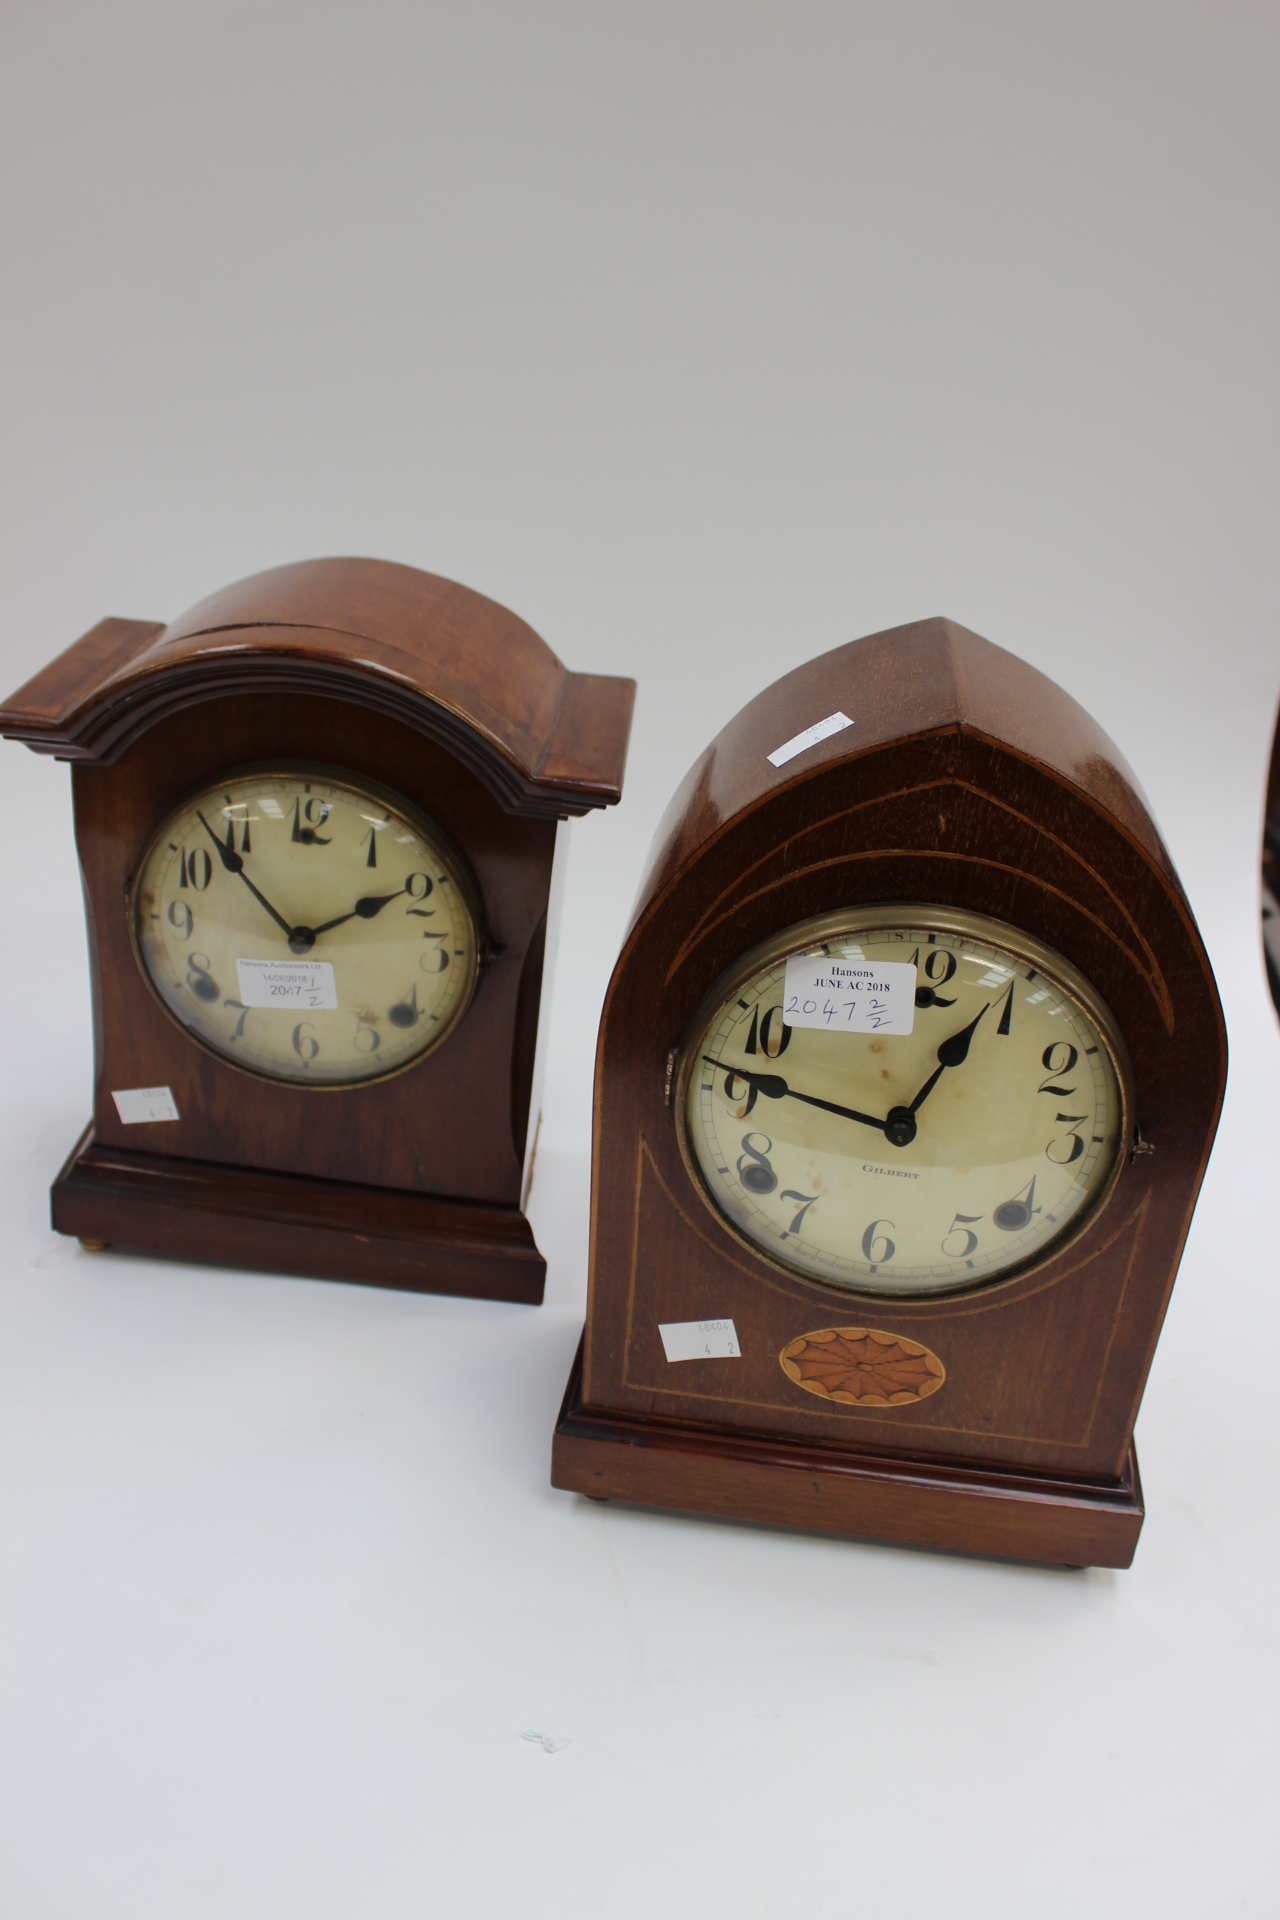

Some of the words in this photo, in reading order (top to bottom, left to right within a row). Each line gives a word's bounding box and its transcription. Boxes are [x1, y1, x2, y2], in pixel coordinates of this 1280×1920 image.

[285, 796, 333, 845] 12
[360, 824, 377, 868] 1
[172, 845, 212, 892] 10
[405, 872, 436, 917] 2
[167, 900, 194, 942] 9
[240, 960, 269, 968] Hansons
[419, 931, 449, 974] 3
[831, 966, 874, 978] Hansons
[270, 985, 301, 996] 2047
[814, 979, 844, 989] JUNE
[847, 981, 864, 991] AC
[866, 982, 891, 992] 2018
[991, 979, 1015, 1036] 1
[223, 999, 250, 1036] 7
[739, 1003, 792, 1058] 10
[785, 996, 856, 1024] 2047
[292, 1023, 319, 1060] 6
[1038, 1042, 1078, 1096] 2
[724, 1068, 758, 1119] 9
[736, 1132, 772, 1188] 8
[1046, 1113, 1089, 1164] 3
[862, 1164, 920, 1180] GILBERT
[780, 1189, 821, 1234] 7
[861, 1219, 895, 1263] 6
[941, 1213, 985, 1257] 5
[704, 1344, 711, 1355] 4
[727, 1342, 734, 1354] 2
